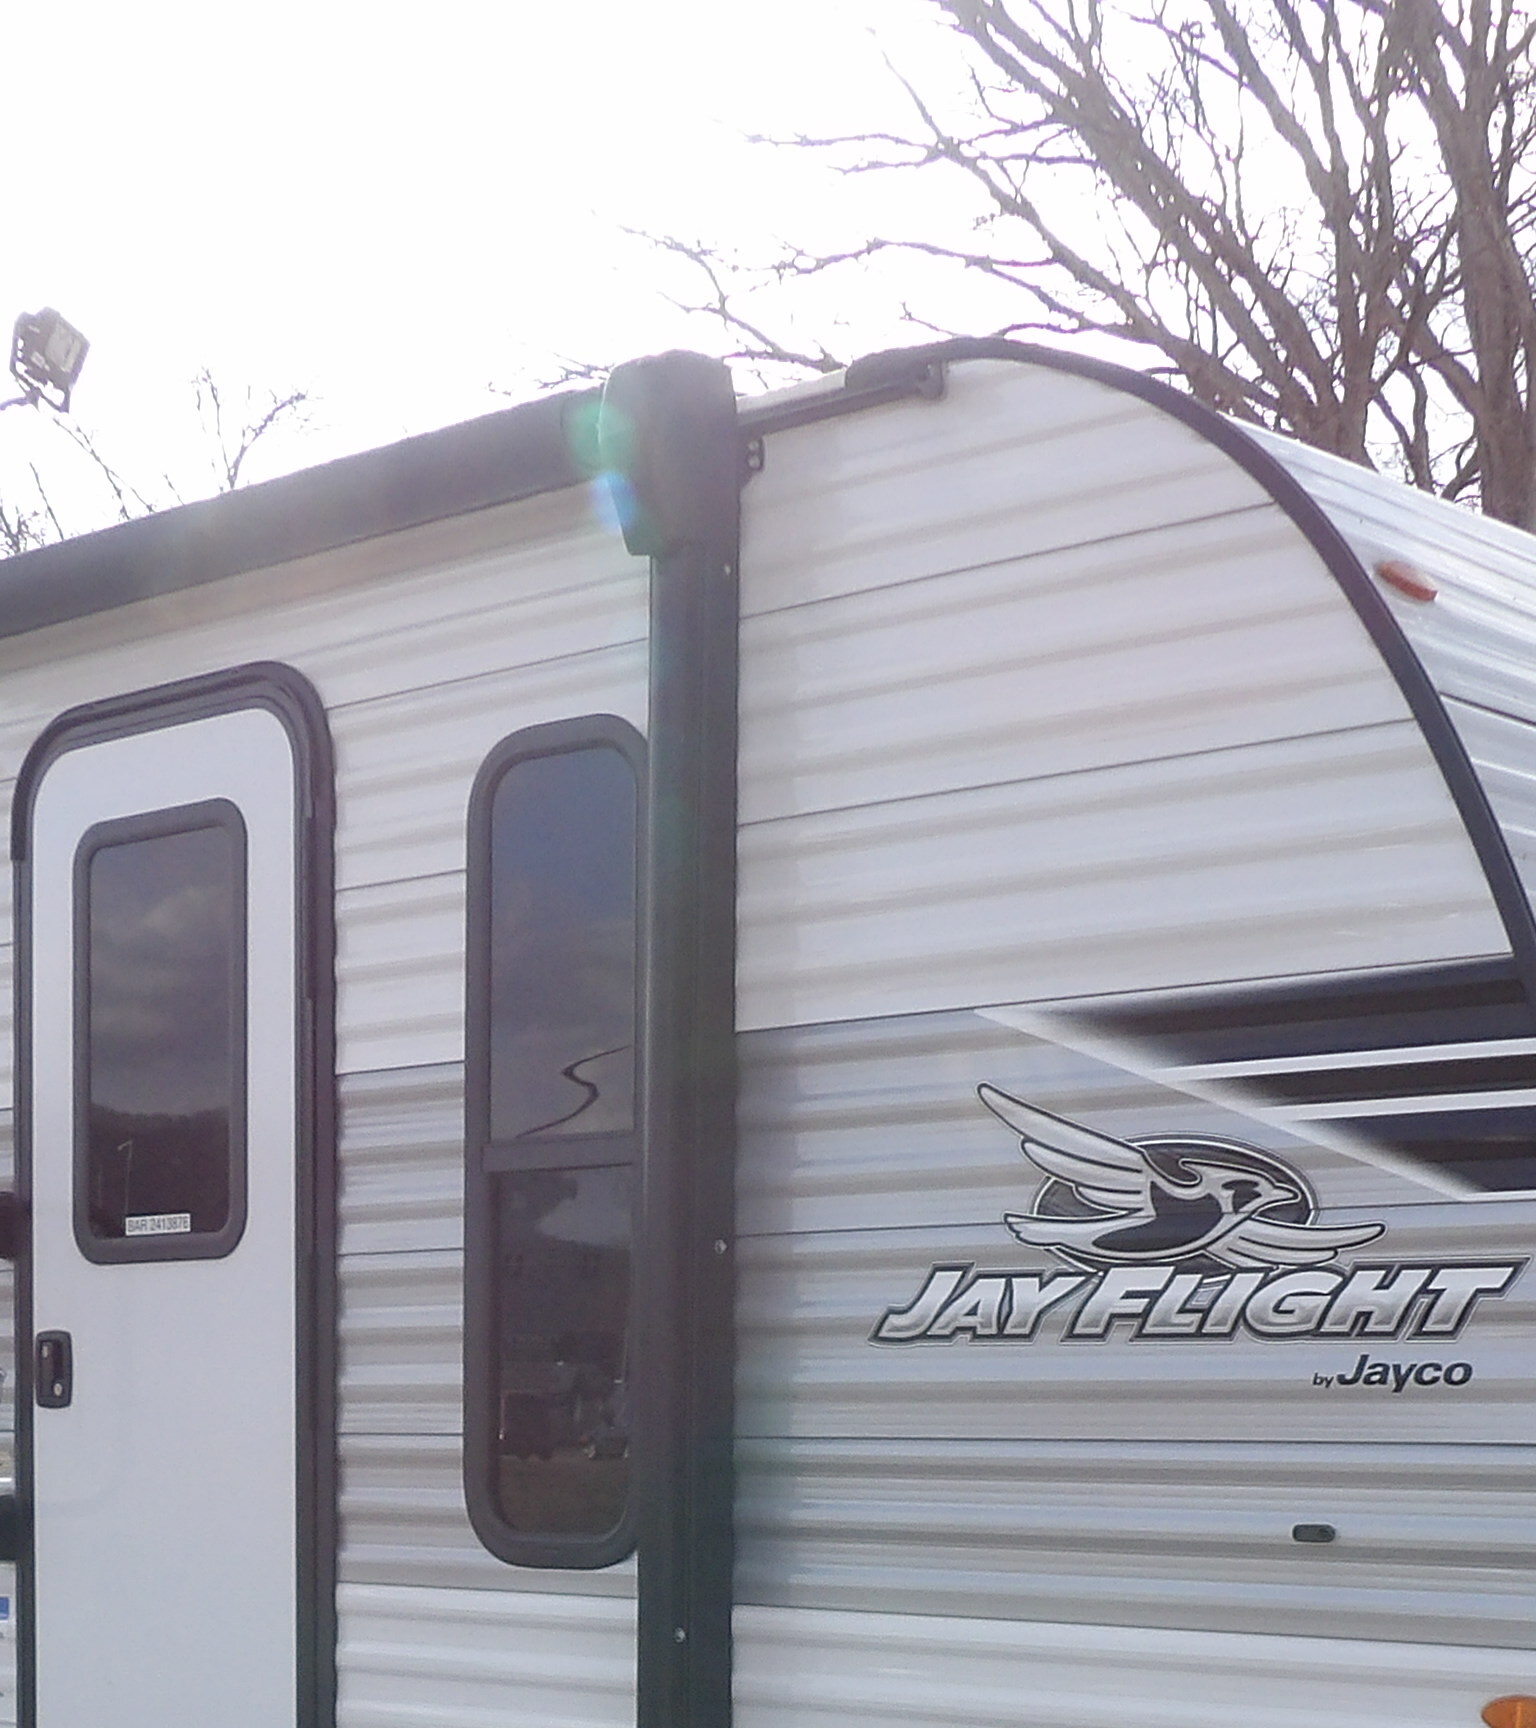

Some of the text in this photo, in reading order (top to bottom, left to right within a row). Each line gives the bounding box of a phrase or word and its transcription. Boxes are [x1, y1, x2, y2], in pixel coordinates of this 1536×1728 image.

[867, 1257, 1531, 1343] JAY FLIGHT
[1313, 1353, 1473, 1393] by Jayco
